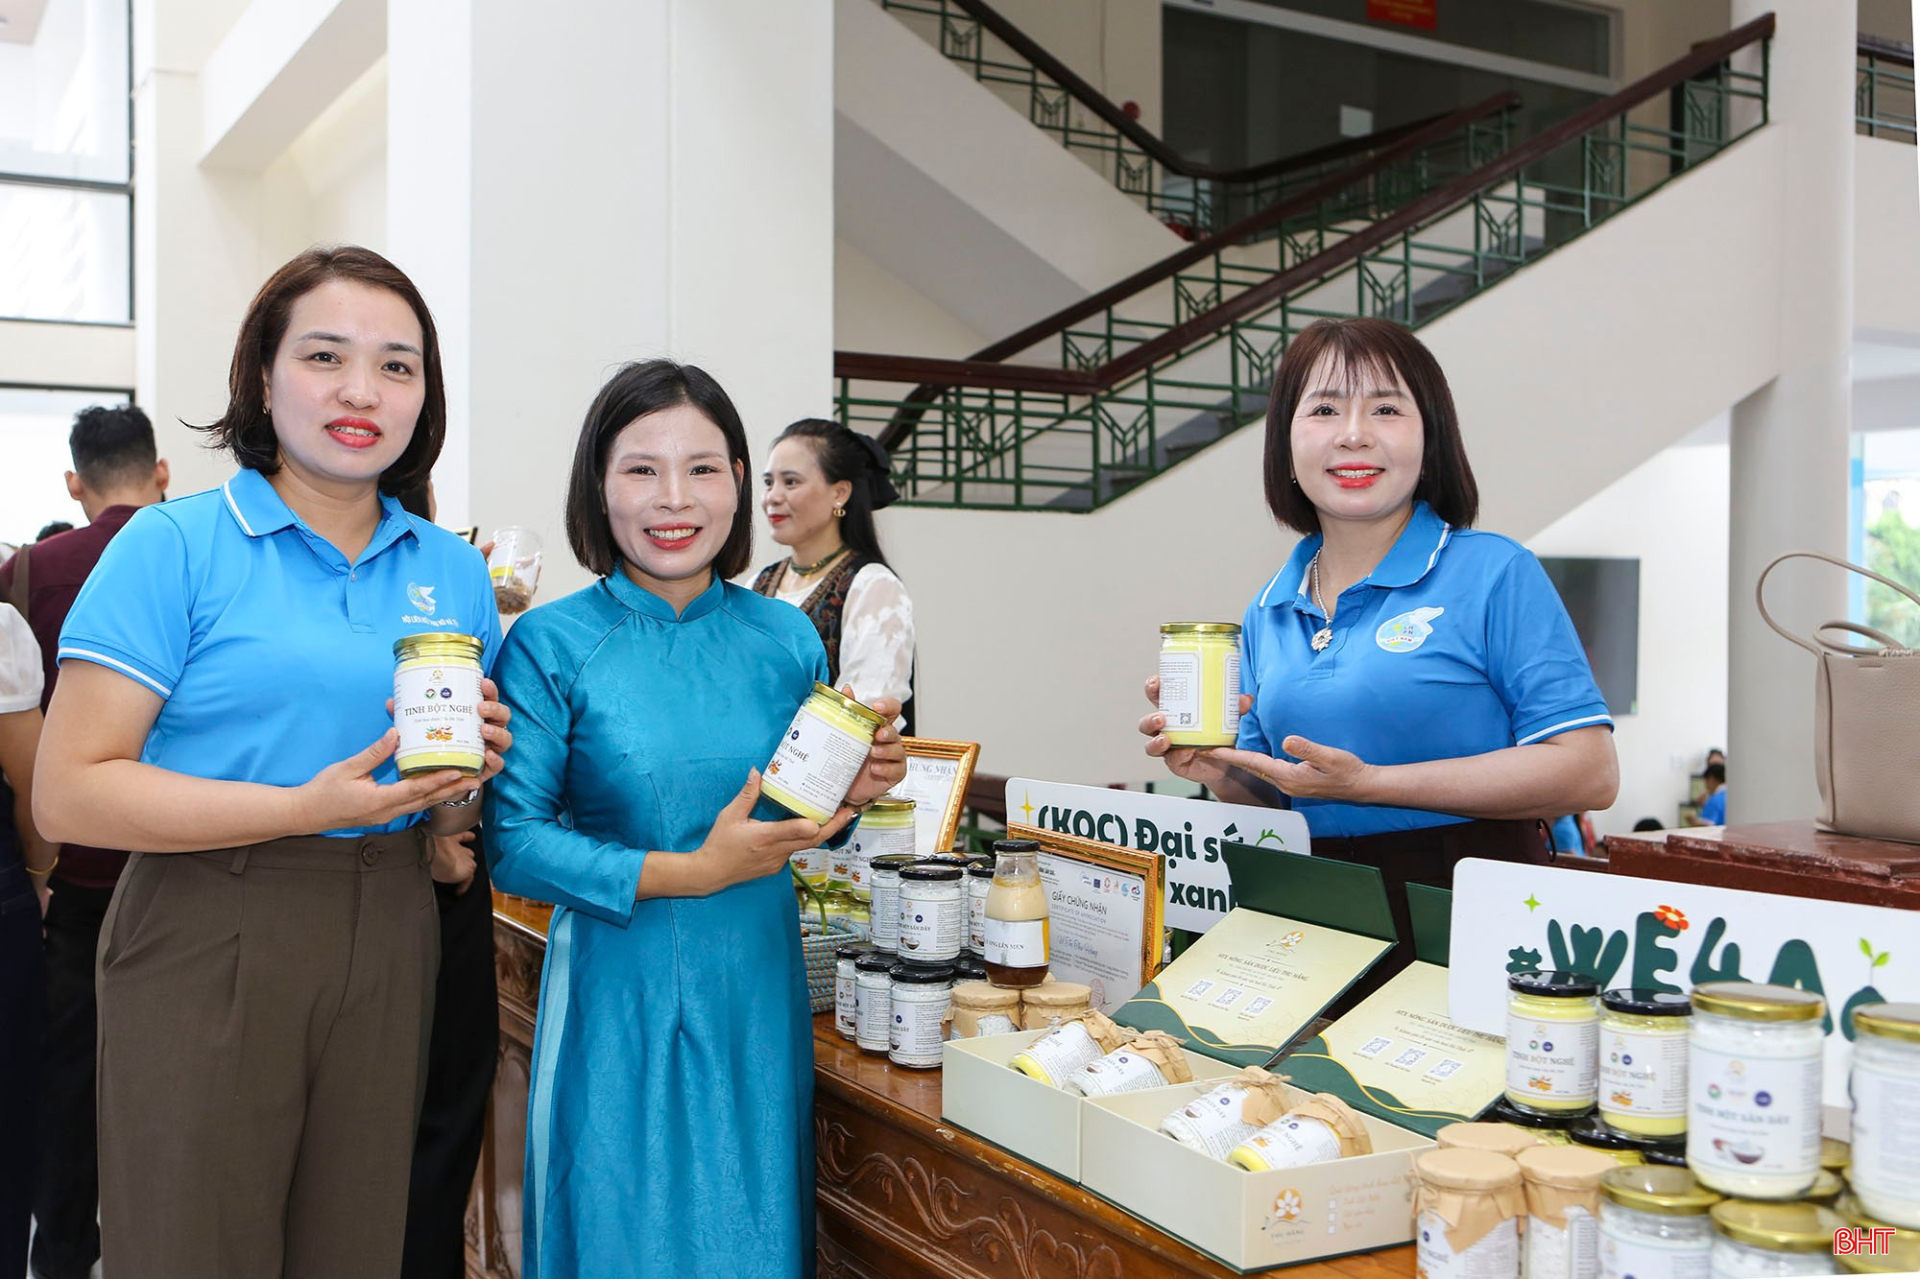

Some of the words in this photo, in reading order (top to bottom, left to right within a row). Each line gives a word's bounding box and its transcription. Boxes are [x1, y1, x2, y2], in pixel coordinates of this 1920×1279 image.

[405, 704, 425, 716] TINH
[428, 703, 446, 714] BỘT
[1038, 805, 1128, 847] (KOC)
[1135, 818, 1197, 869] Đại
[1052, 890, 1066, 903] GIẤY
[1089, 902, 1107, 916] NHẬN
